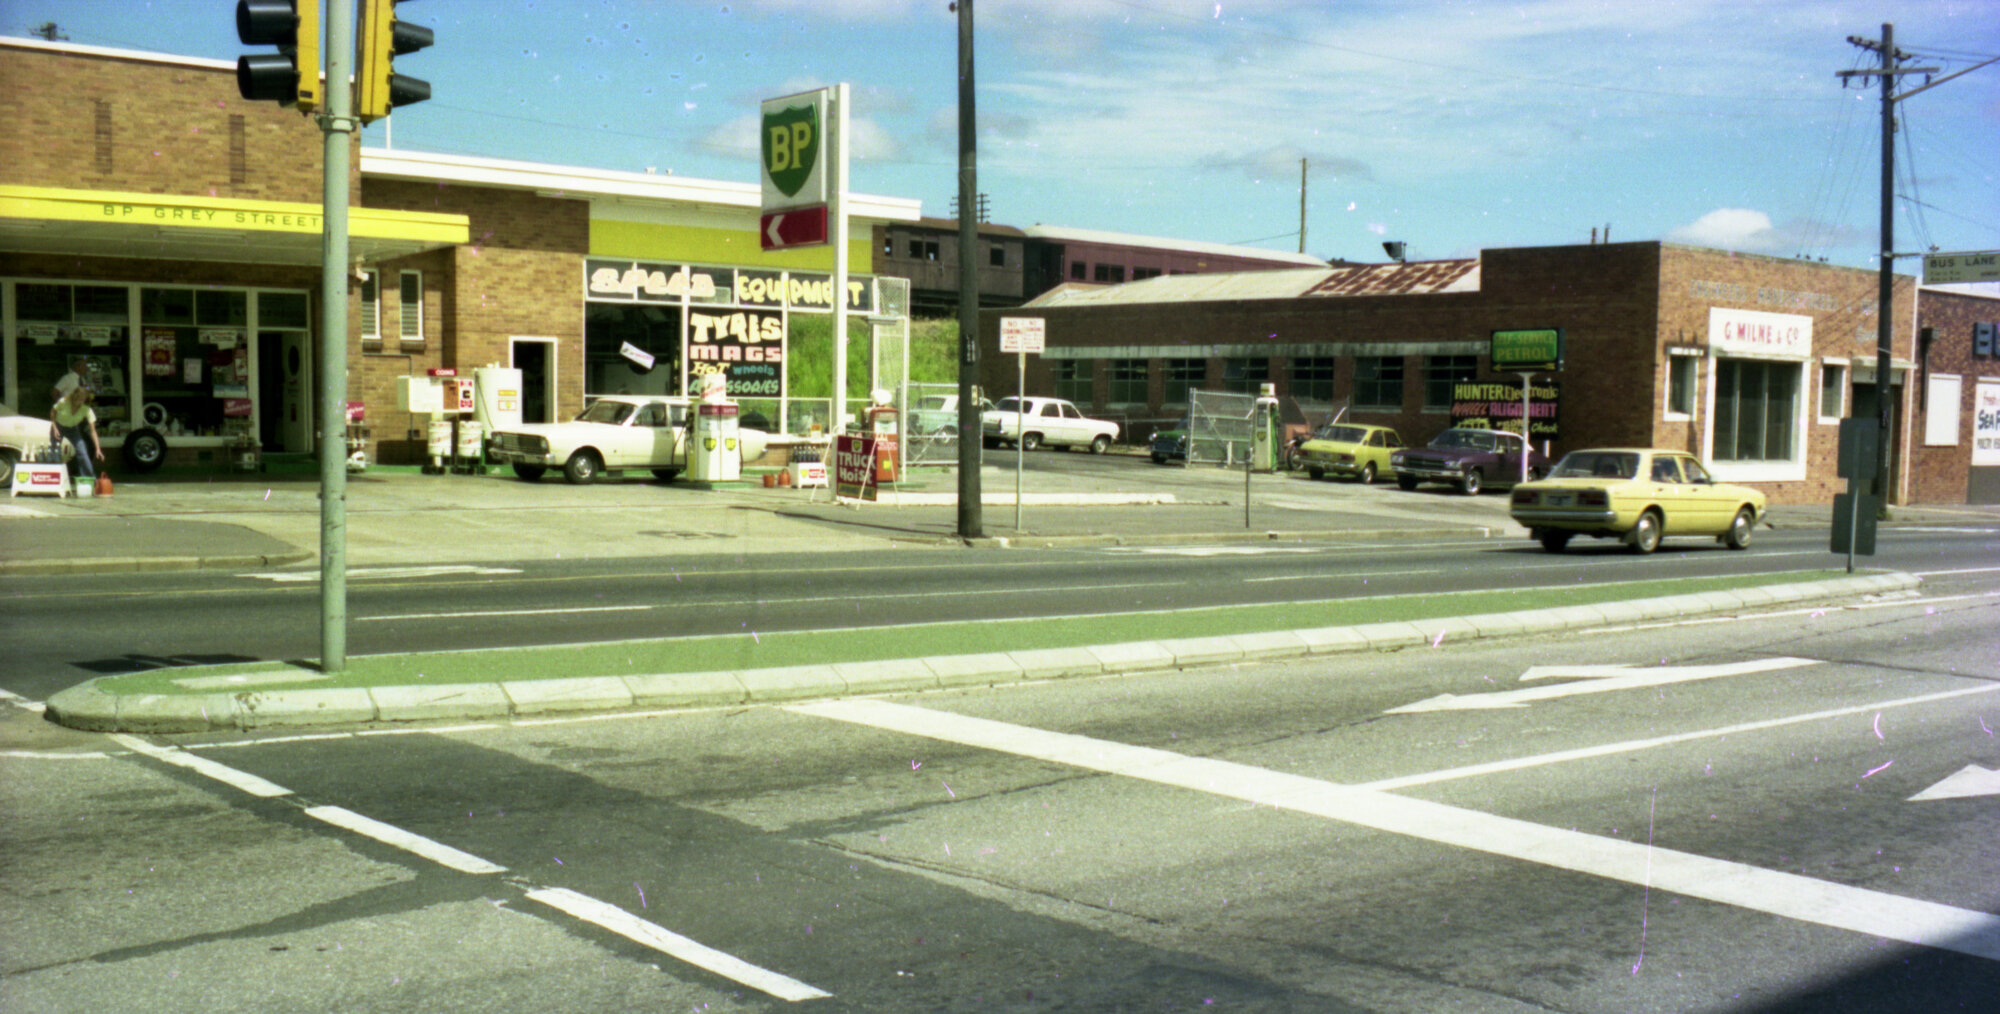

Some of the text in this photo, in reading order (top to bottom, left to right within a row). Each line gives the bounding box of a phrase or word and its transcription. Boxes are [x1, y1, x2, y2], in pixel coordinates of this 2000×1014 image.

[770, 121, 811, 173] BP
[104, 204, 319, 227] BP GREY STREET
[1930, 255, 1996, 268] BUS LANE
[737, 275, 865, 307] EQUIPMET
[690, 312, 783, 344] TYRES
[1724, 321, 1732, 341] G
[1737, 322, 1772, 344] MILNE
[690, 345, 782, 362] MAGS
[1496, 347, 1550, 361] PETROL
[689, 379, 779, 395] ASSORIES
[1454, 384, 1559, 401] HUNTER Elecronic
[838, 452, 876, 470] TRUCK
